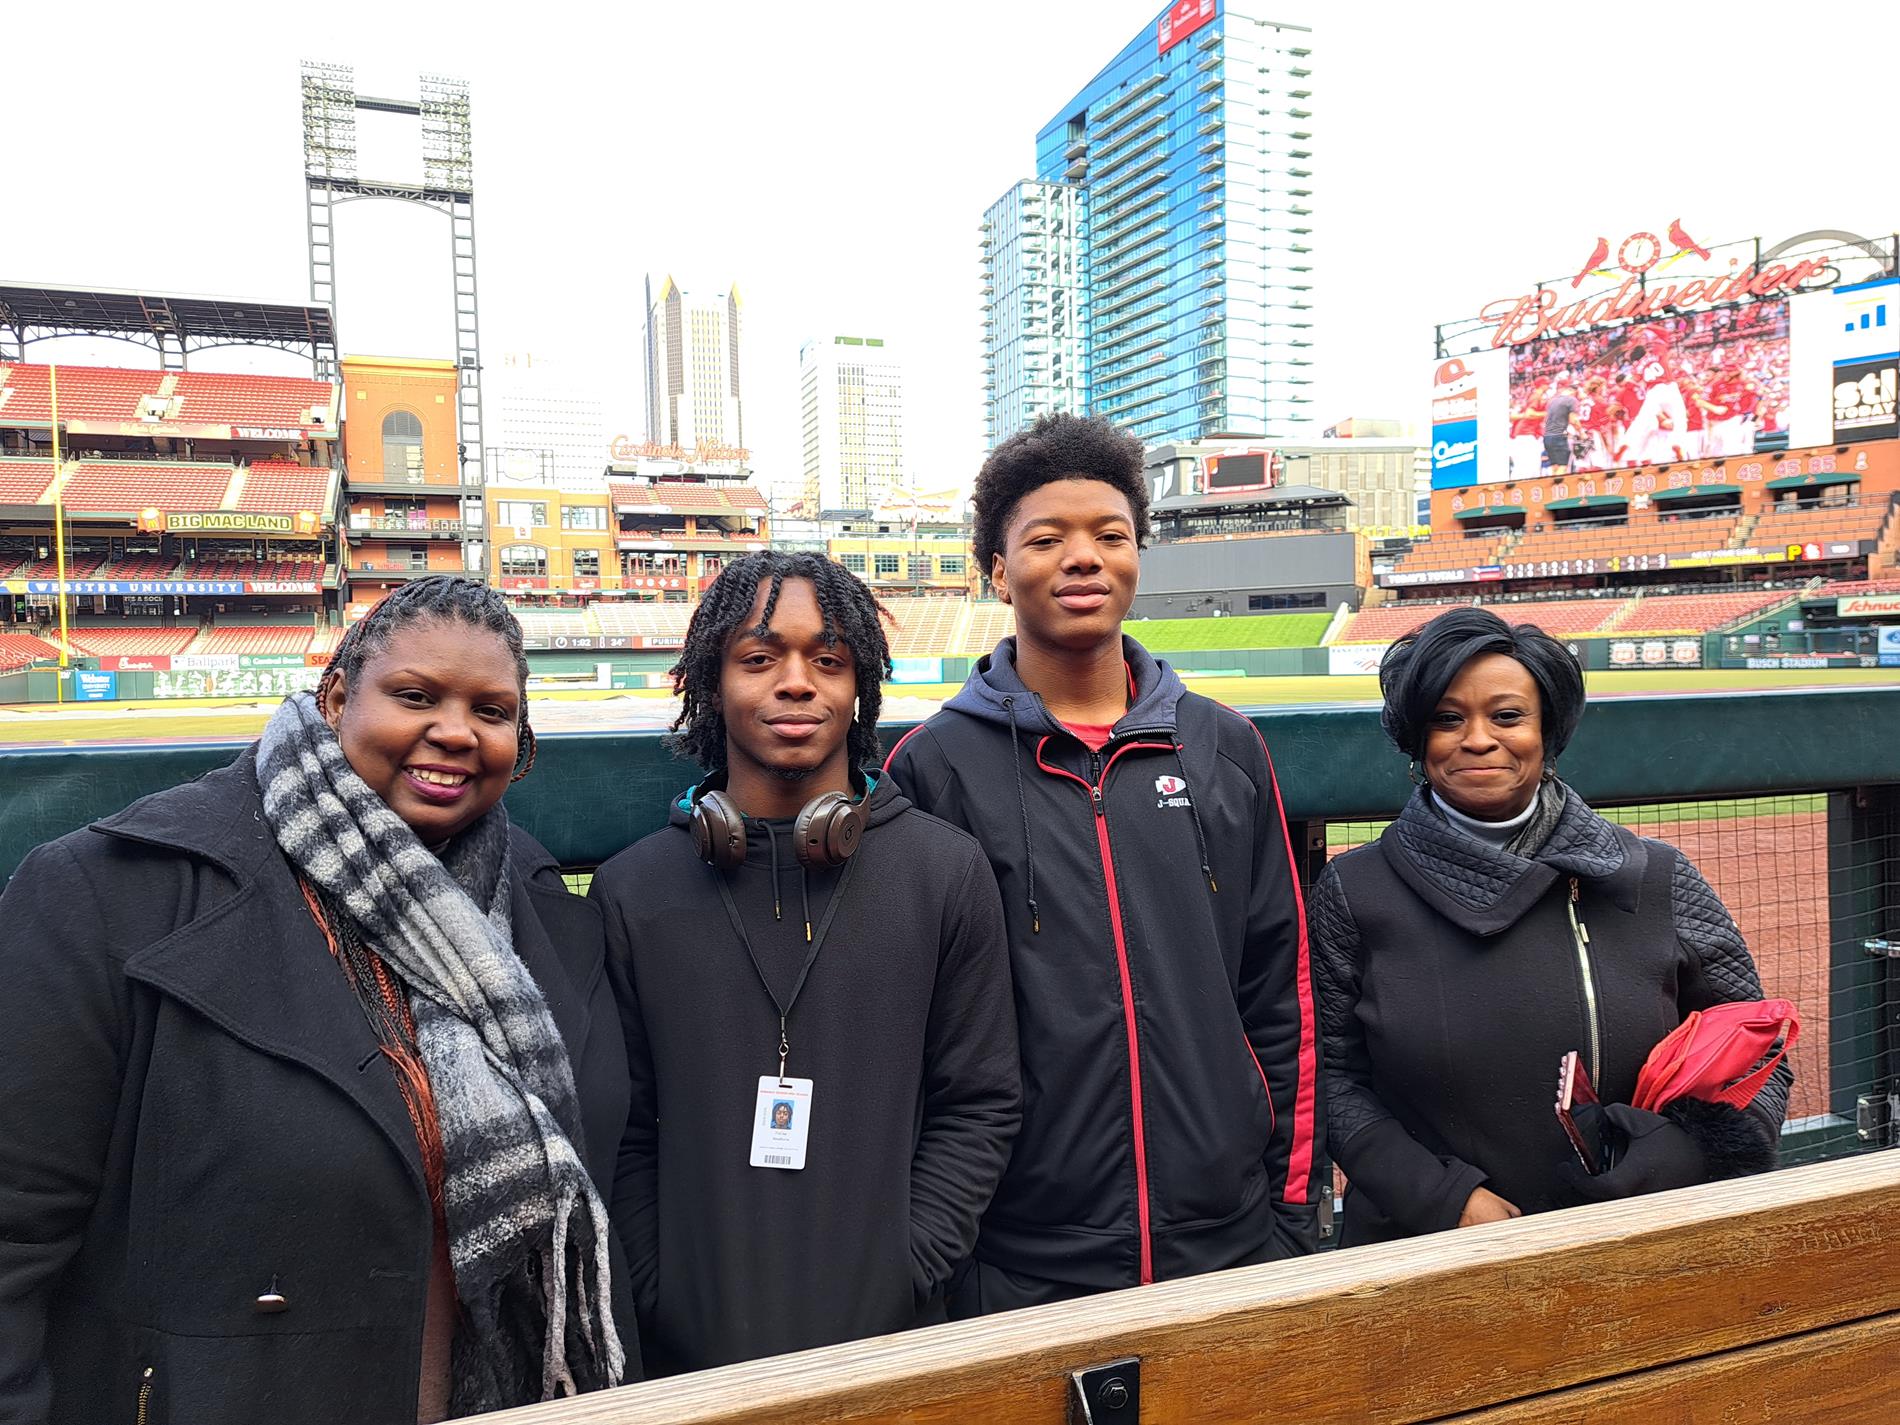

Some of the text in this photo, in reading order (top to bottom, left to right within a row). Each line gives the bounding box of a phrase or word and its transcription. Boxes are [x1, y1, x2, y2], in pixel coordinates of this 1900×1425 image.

[1479, 257, 1829, 348] Budweiser
[1833, 368, 1896, 409] stl
[1834, 401, 1897, 420] TODAY
[238, 427, 302, 440] WELCOME
[611, 434, 750, 464] Cardinals Nation
[1478, 492, 1486, 507] 1
[1531, 486, 1544, 503] 9
[1551, 484, 1569, 500] 10
[1577, 480, 1596, 498] 14
[1604, 478, 1624, 496] 17
[1632, 475, 1657, 493] 20
[1667, 471, 1693, 489] 23
[1700, 467, 1727, 486] 24
[1736, 463, 1763, 481] 42
[1774, 459, 1802, 478] 45
[168, 513, 292, 530] BIG MAC LAND
[1387, 570, 1465, 584] TODAY'S TOTALS
[35, 582, 237, 593] WEBSTER UNIVERSITY
[249, 582, 317, 593] WELCOME
[571, 638, 592, 647] 1:02
[652, 637, 686, 646] PURINA
[187, 656, 237, 668] Ballpark
[252, 656, 282, 665] Central
[311, 655, 332, 666] SEA
[1746, 657, 1829, 669] BUSCH STADIUM
[79, 672, 111, 683] Webster
[1162, 778, 1177, 793] J
